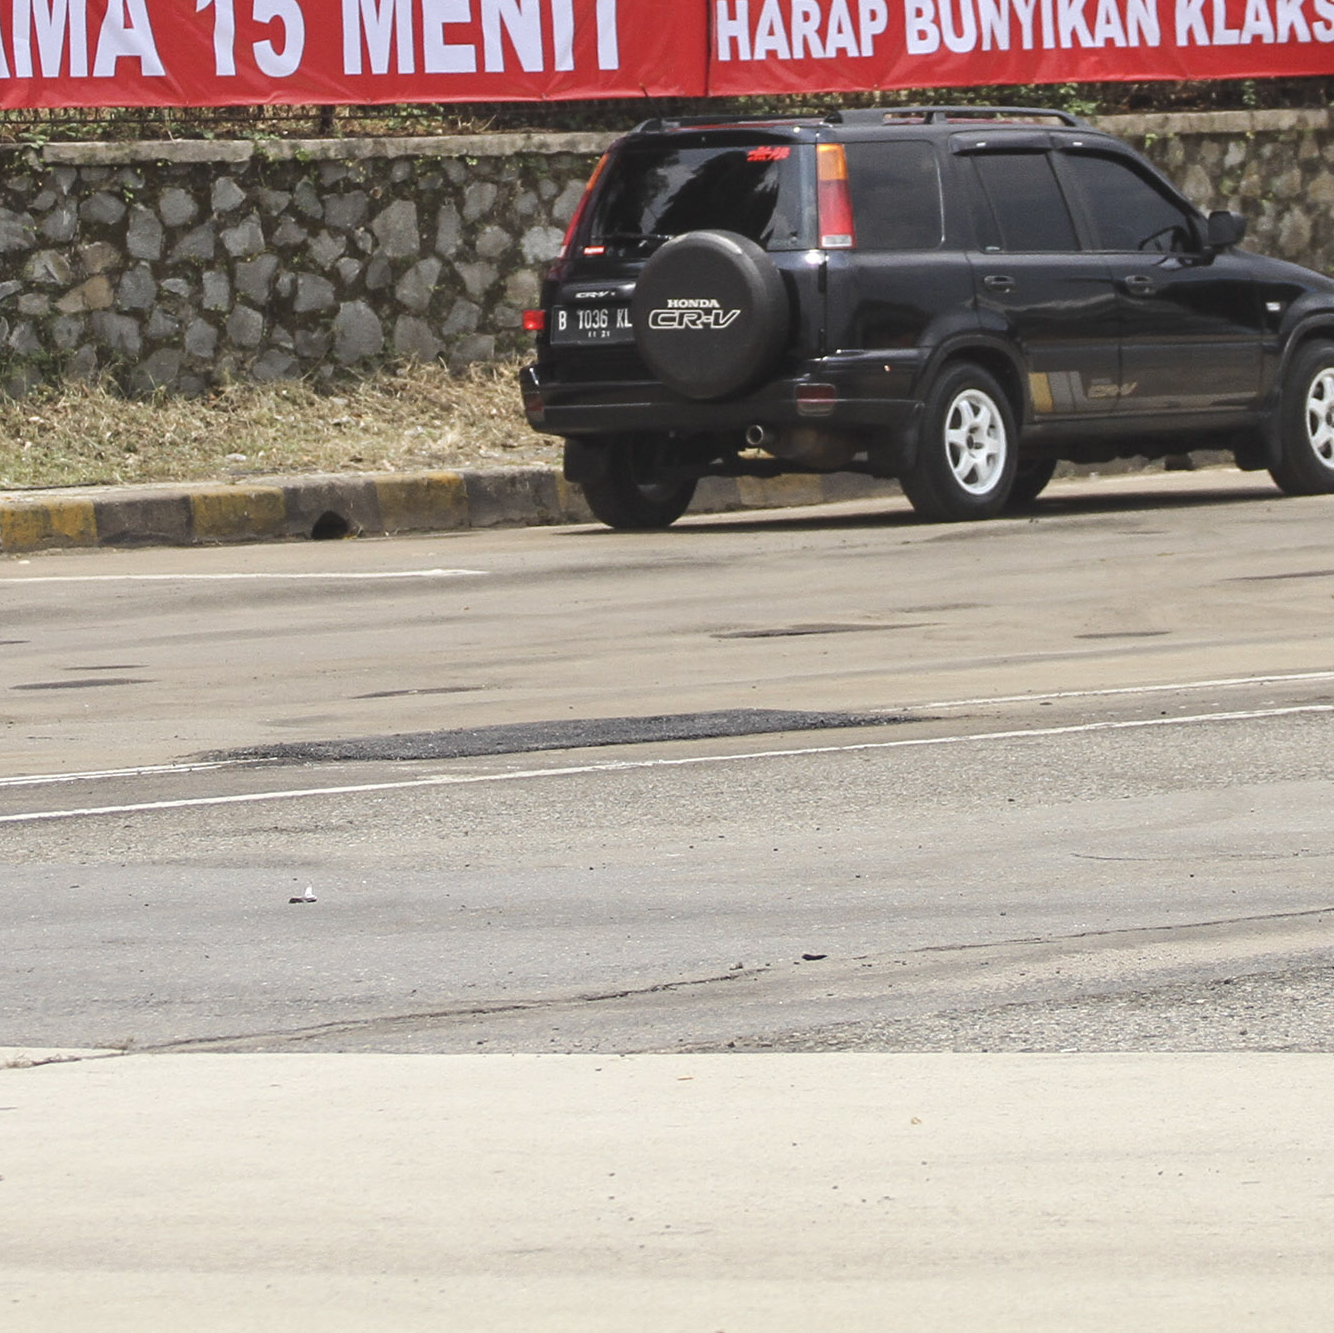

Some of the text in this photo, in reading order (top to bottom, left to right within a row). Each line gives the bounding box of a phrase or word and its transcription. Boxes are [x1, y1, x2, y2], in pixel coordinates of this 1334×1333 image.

[667, 298, 720, 308] HONDA
[558, 310, 567, 330] B
[576, 309, 609, 329] 1036
[648, 309, 741, 329] CR-V
